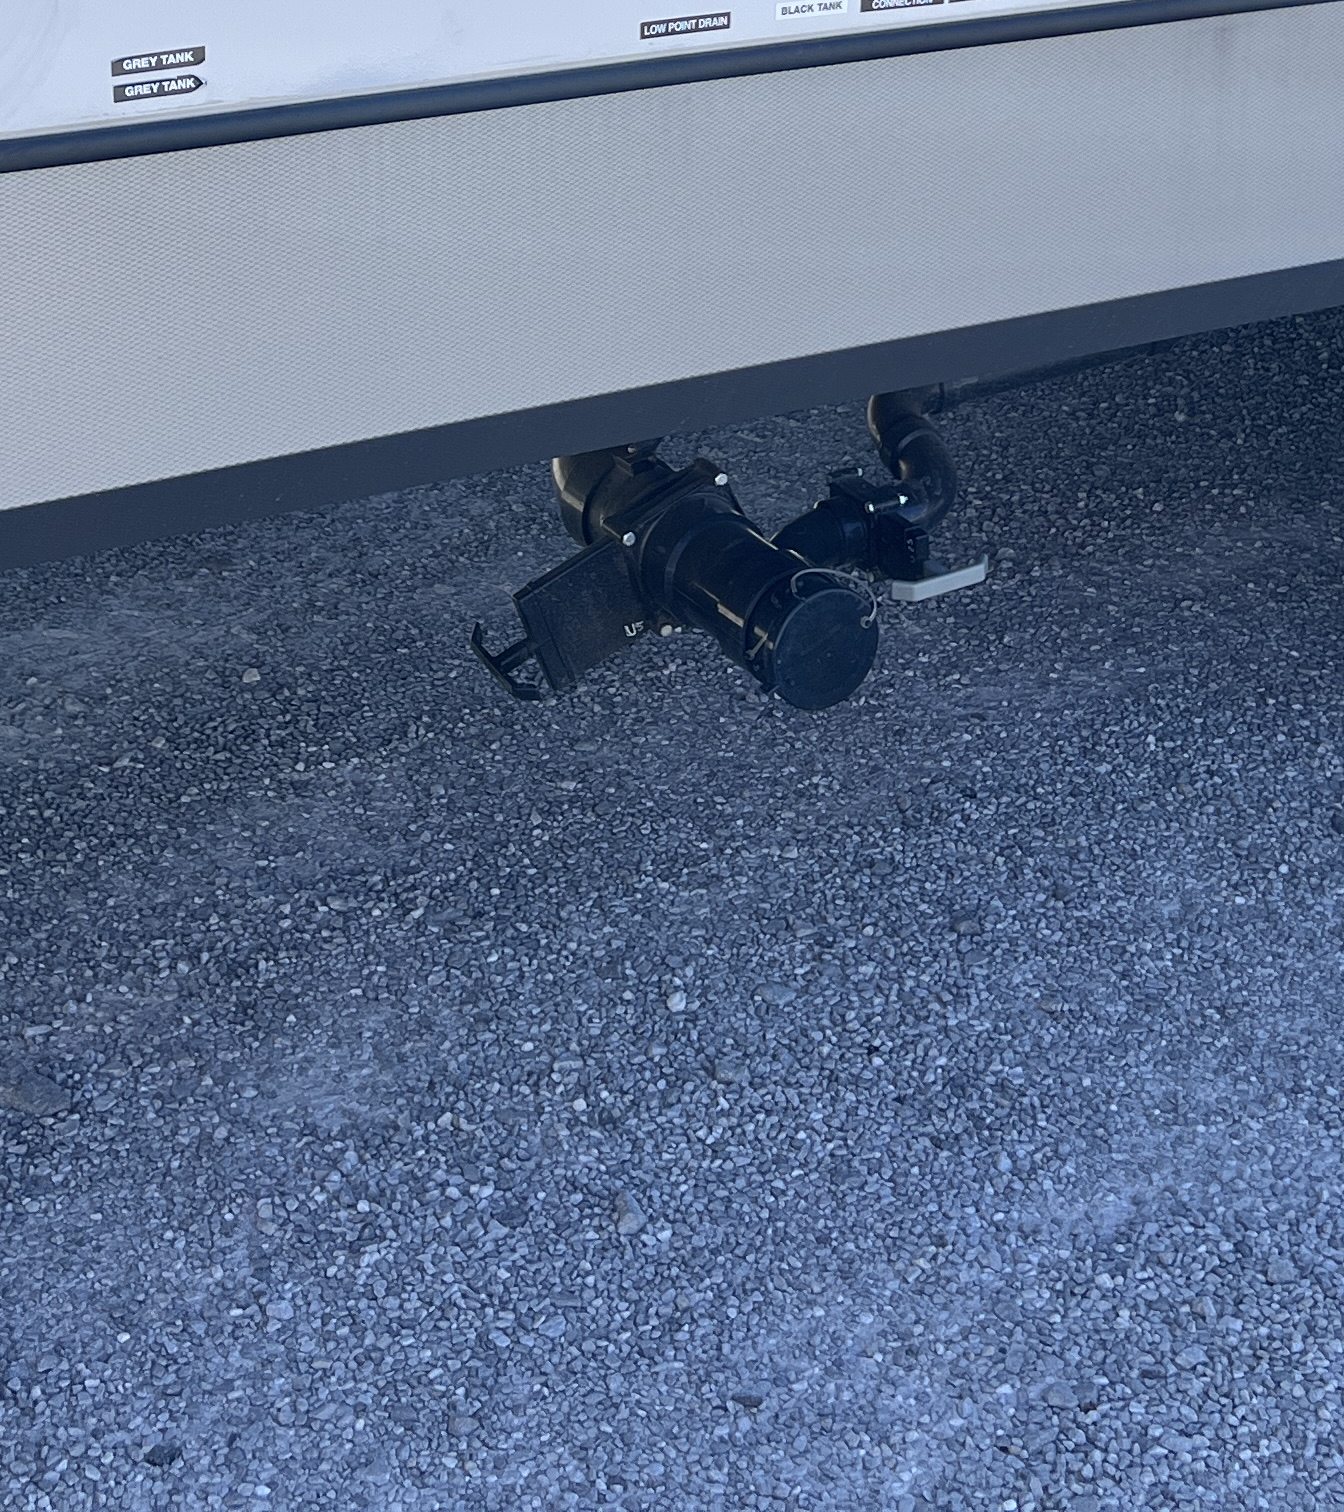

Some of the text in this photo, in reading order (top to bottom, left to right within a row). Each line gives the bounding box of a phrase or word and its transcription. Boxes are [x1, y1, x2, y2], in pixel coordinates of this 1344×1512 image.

[780, 0, 843, 16] BLACK TANK
[644, 16, 728, 36] LOW POINT DRAIN
[122, 51, 194, 70] GREY TANK
[124, 78, 196, 97] GREY TANK
